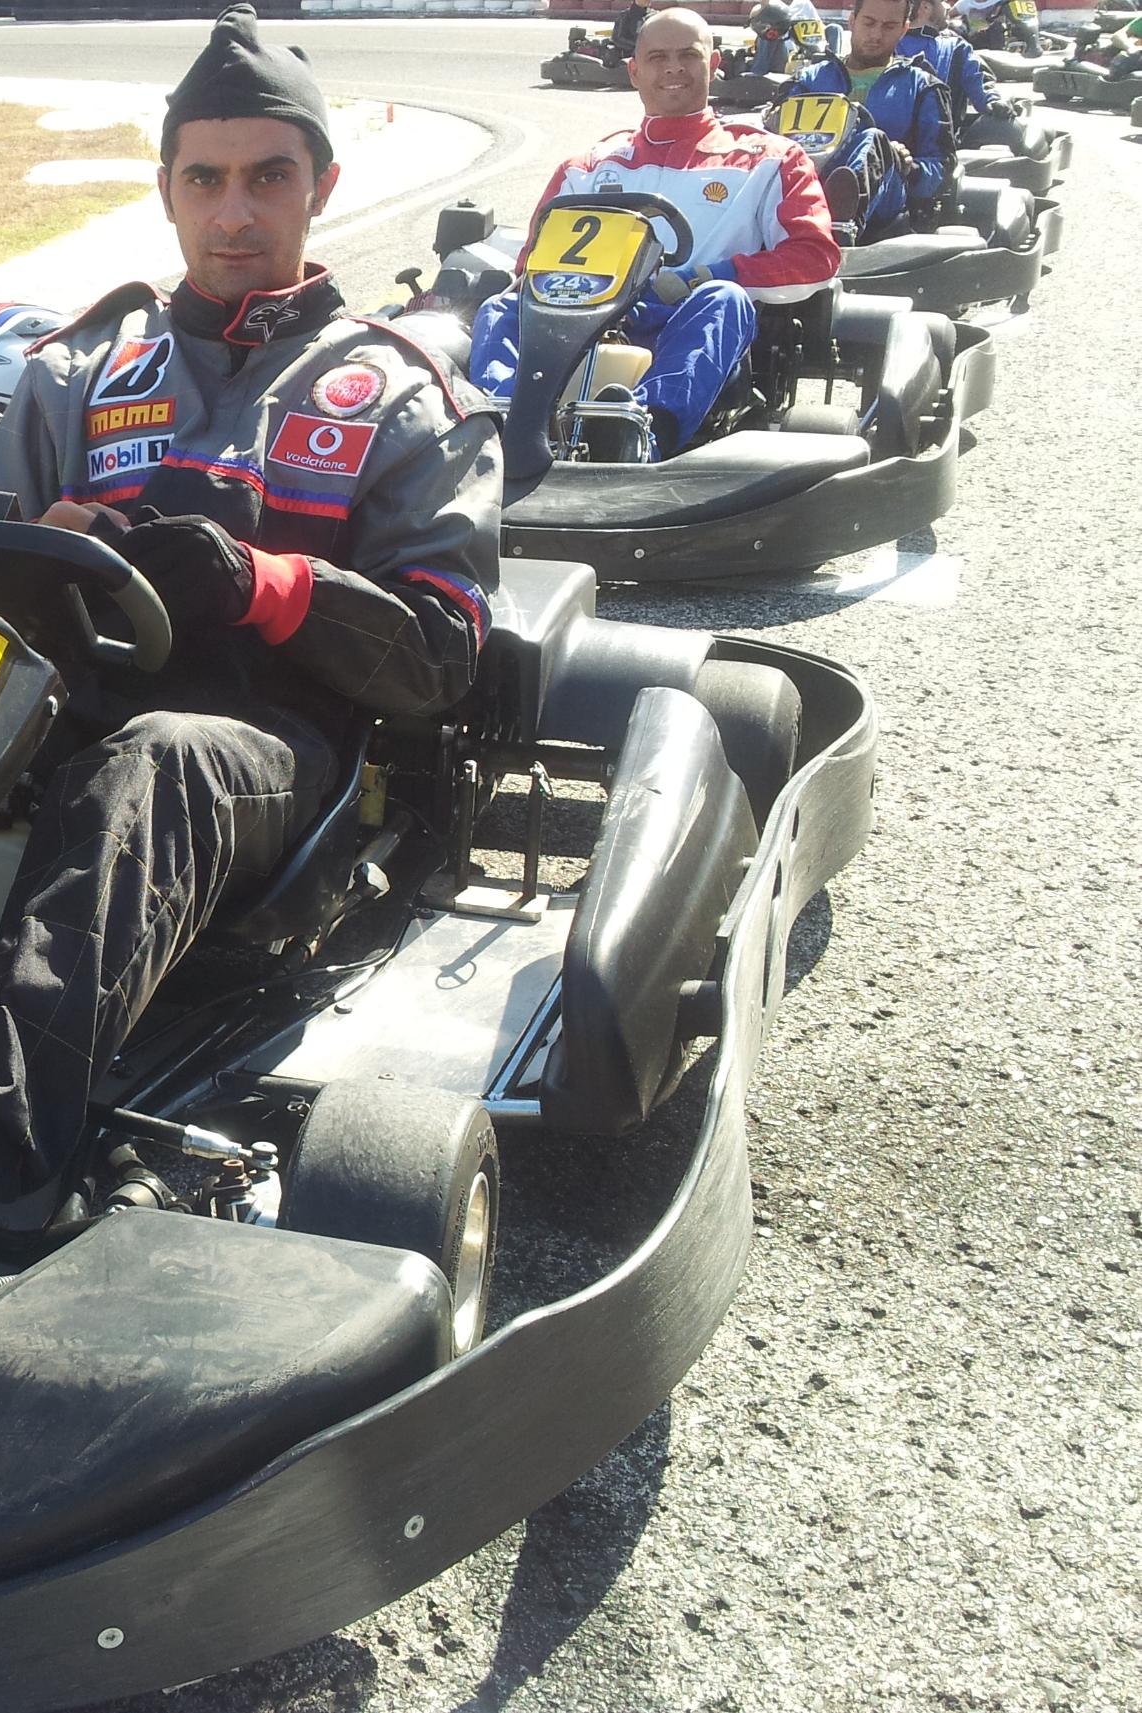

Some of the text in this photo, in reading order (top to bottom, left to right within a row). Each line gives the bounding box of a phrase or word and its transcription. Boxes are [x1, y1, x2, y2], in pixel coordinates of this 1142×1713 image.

[801, 22, 820, 35] 22
[788, 98, 834, 130] 17
[559, 215, 602, 266] 2
[549, 276, 581, 289] 24
[90, 442, 142, 477] Mobil
[285, 451, 347, 470] vodafone
